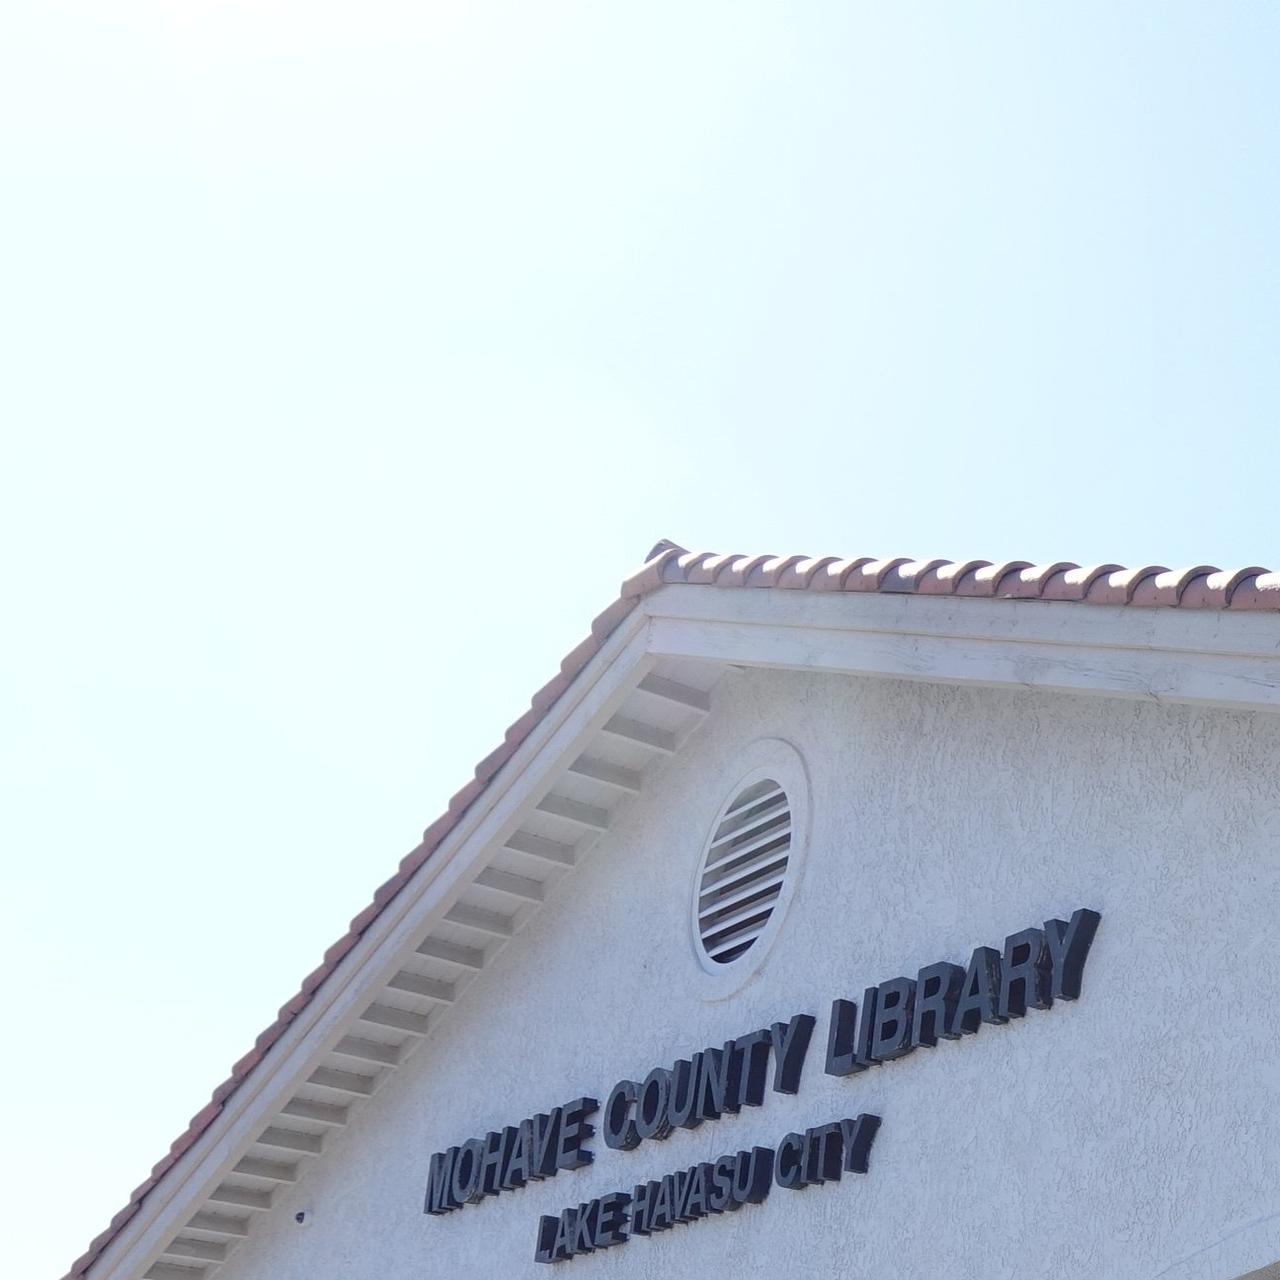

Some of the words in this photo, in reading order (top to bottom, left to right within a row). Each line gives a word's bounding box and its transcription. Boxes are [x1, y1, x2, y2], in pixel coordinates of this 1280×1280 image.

[424, 1097, 598, 1215] MOHAVE
[602, 1013, 816, 1151] COUNTY
[822, 908, 1100, 1077] LIBRARY
[534, 1192, 636, 1264] LAKE
[631, 1147, 775, 1236] HAVASU
[774, 1113, 882, 1191] CITY
